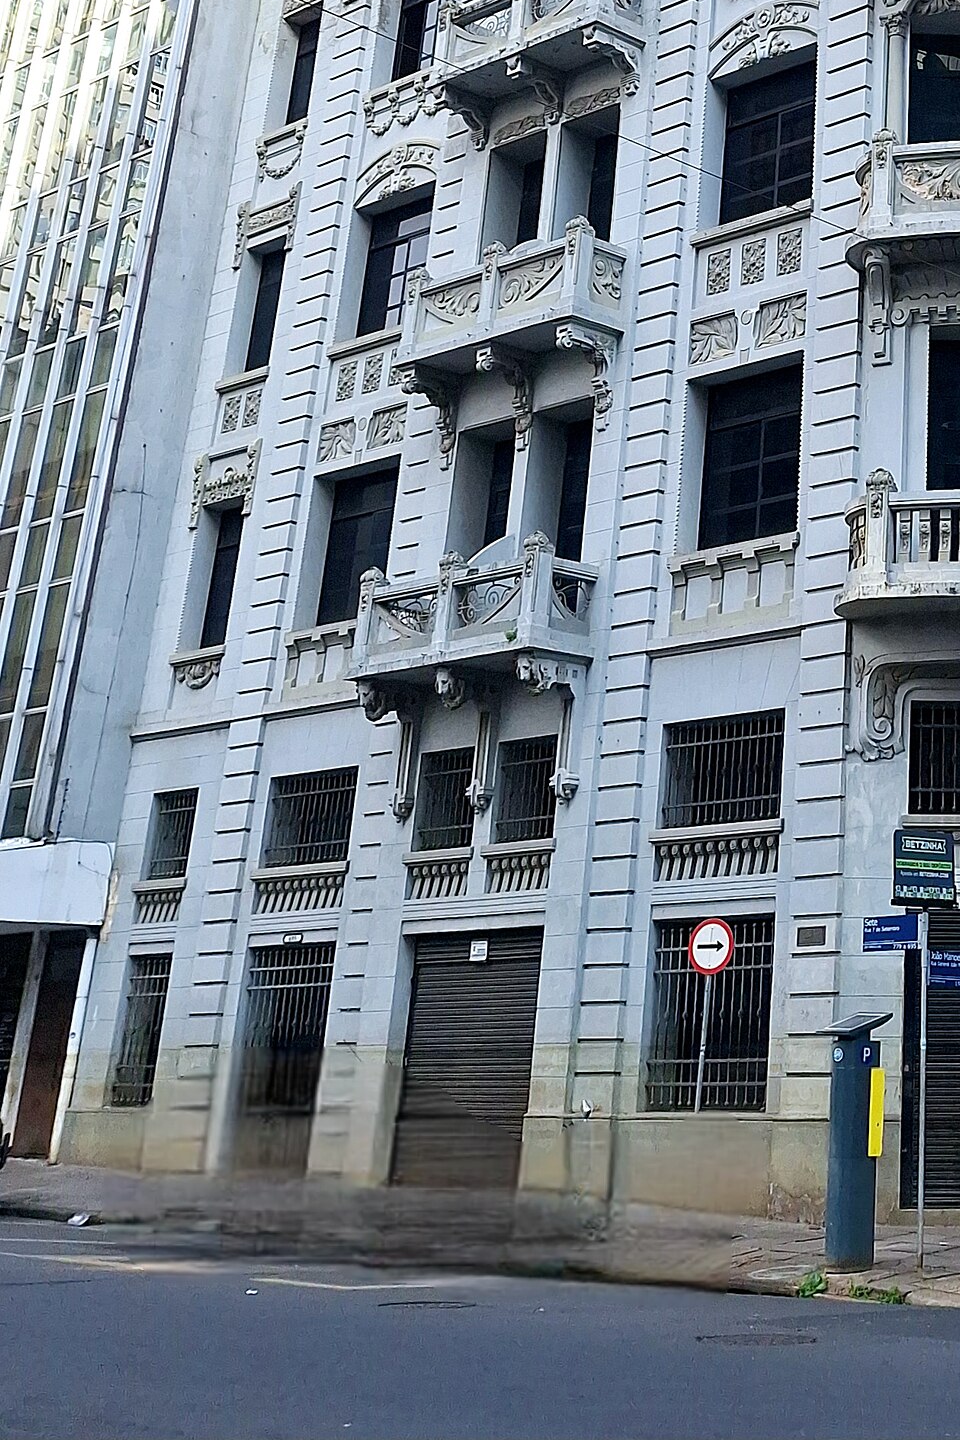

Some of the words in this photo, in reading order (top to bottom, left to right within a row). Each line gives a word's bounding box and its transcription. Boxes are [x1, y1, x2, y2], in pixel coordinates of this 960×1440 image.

[905, 840, 943, 850] BETZINHA
[864, 918, 878, 927] Sete
[931, 951, 943, 960] João
[863, 1047, 870, 1062] P
